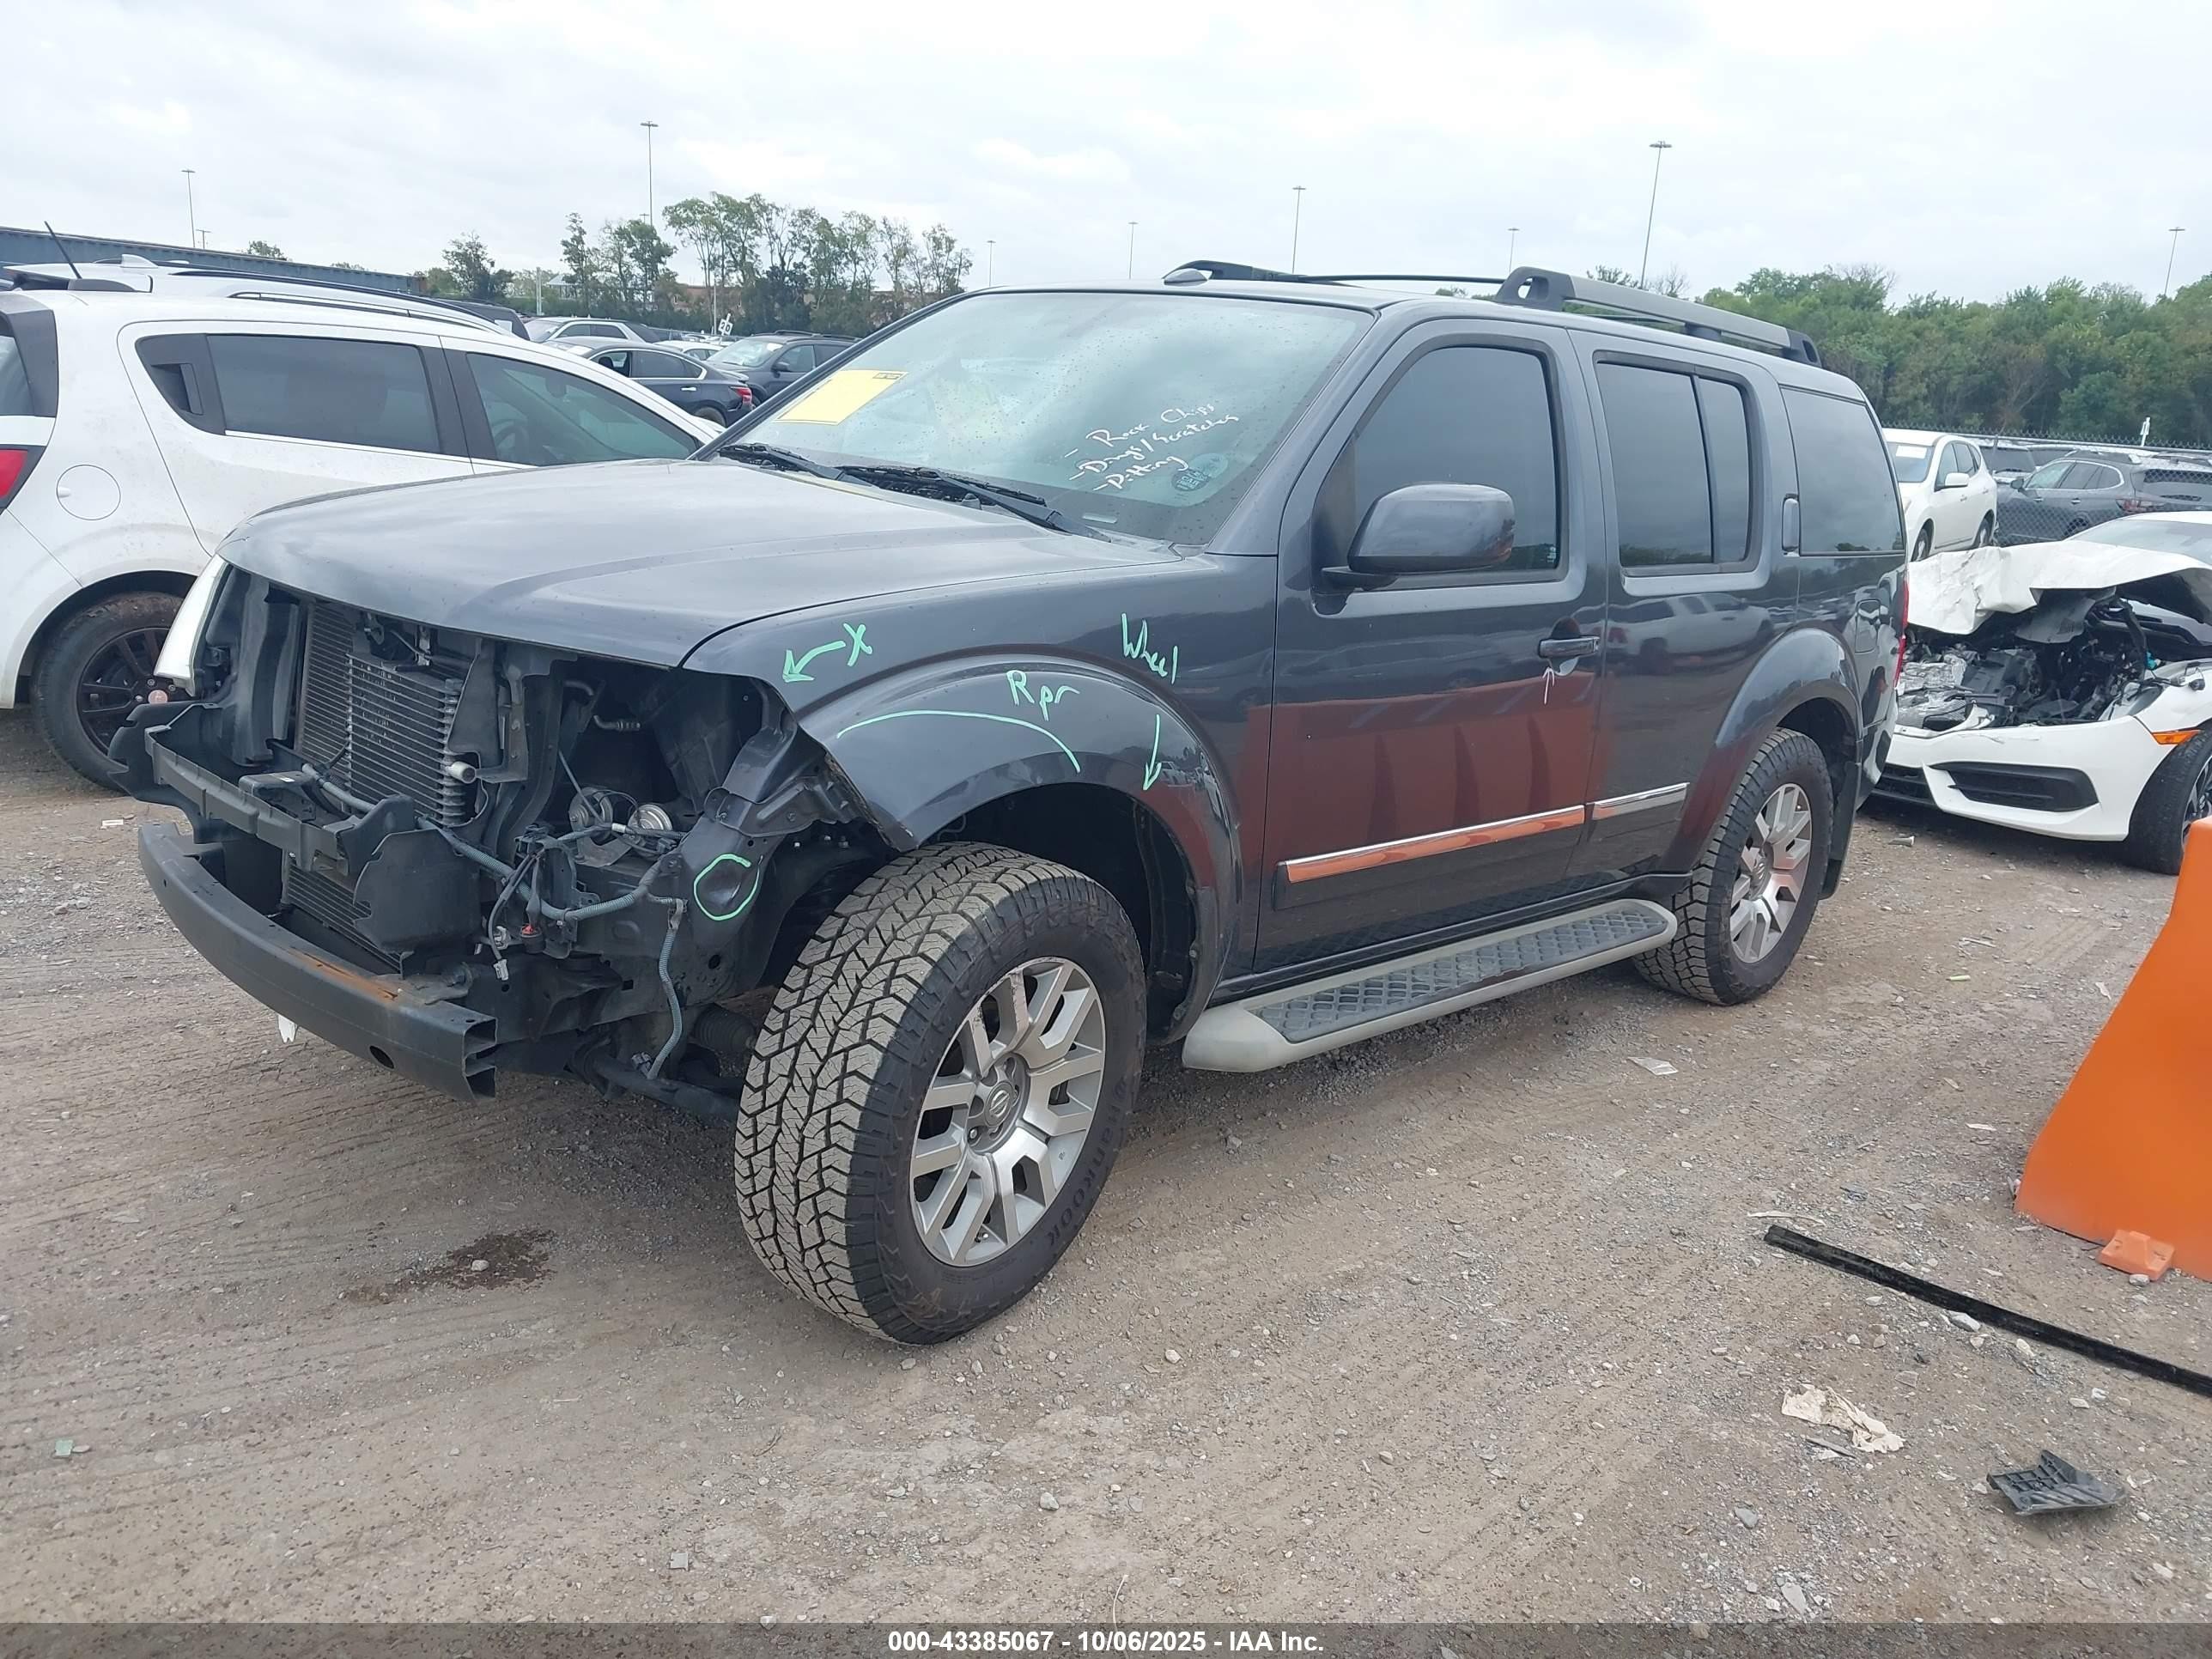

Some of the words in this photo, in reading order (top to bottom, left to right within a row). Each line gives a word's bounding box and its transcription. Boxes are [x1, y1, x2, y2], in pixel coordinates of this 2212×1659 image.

[1085, 423, 1149, 447] Rock
[1121, 612, 1178, 684] Wheel
[1006, 670, 1080, 721] Rpr
